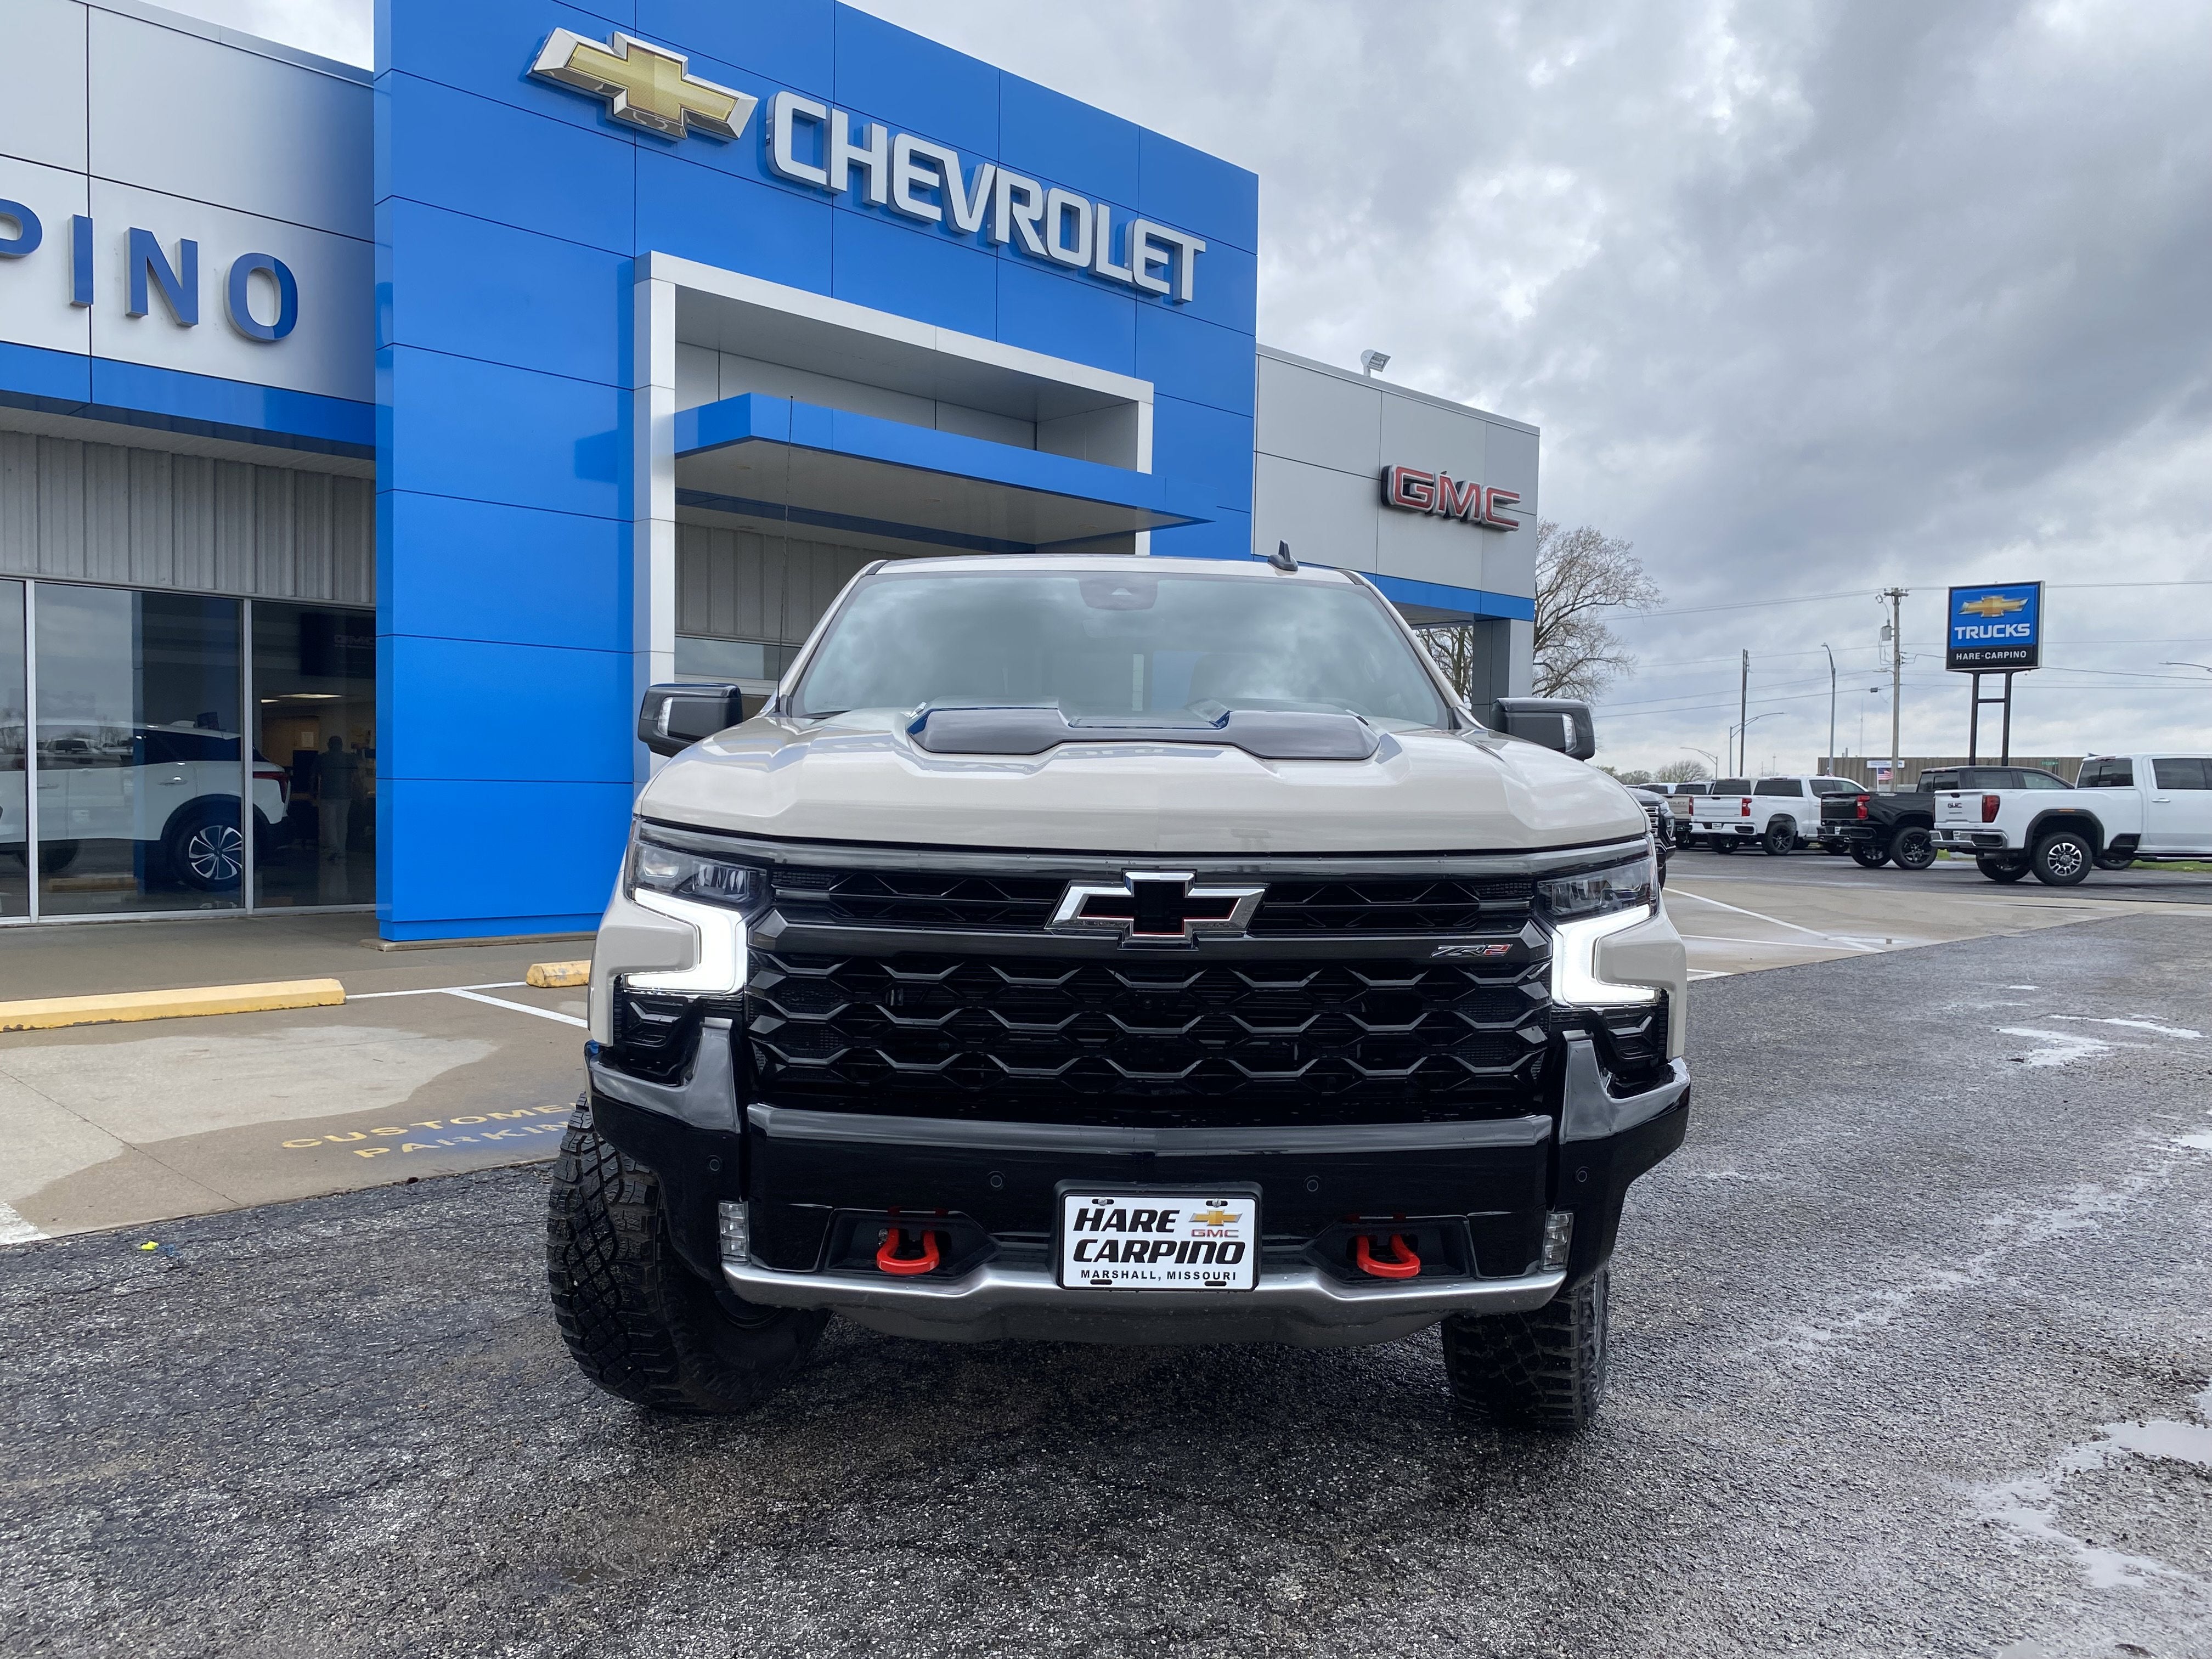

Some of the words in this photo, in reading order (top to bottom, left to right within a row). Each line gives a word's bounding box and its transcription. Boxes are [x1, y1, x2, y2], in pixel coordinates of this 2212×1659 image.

[768, 91, 1206, 303] CHEVROLET
[1382, 464, 1521, 531] GMC
[1954, 623, 2030, 640] TRUCKS
[1956, 650, 2027, 660] HARE-CARPINO
[1430, 943, 1513, 958] ZR2
[282, 1103, 577, 1149] CUSTOME
[1073, 1208, 1180, 1233] HARE
[1191, 1229, 1239, 1238] GMC
[1073, 1239, 1246, 1265] CARPINO
[1081, 1269, 1161, 1281] MARSHALL,
[1166, 1271, 1236, 1280] MISSOURI
